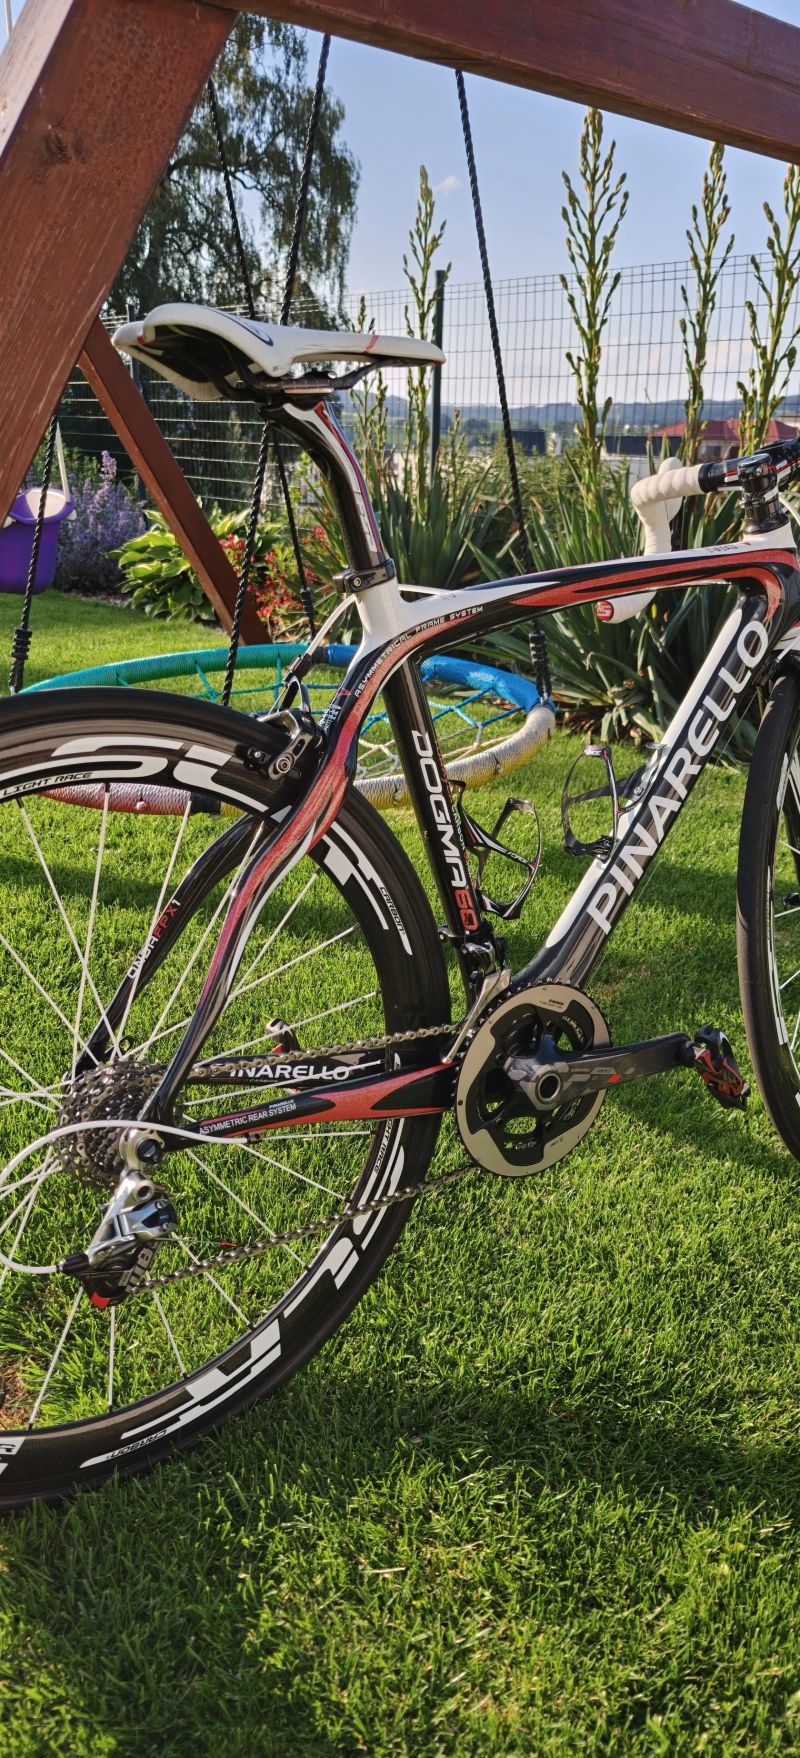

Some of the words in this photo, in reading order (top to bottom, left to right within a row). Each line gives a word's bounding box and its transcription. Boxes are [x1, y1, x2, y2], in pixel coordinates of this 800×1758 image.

[415, 616, 446, 633] FRAME
[449, 606, 483, 620] SYSTEM
[4, 778, 52, 796] LIGHT
[54, 771, 93, 784] RACE
[587, 620, 769, 935] PINARELLO
[380, 886, 405, 932] CARBON
[230, 1064, 352, 1081] INARELLO
[200, 1117, 248, 1134] ASYMMETRIC
[248, 1111, 268, 1123] REAR
[269, 1103, 297, 1117] SYSTEM
